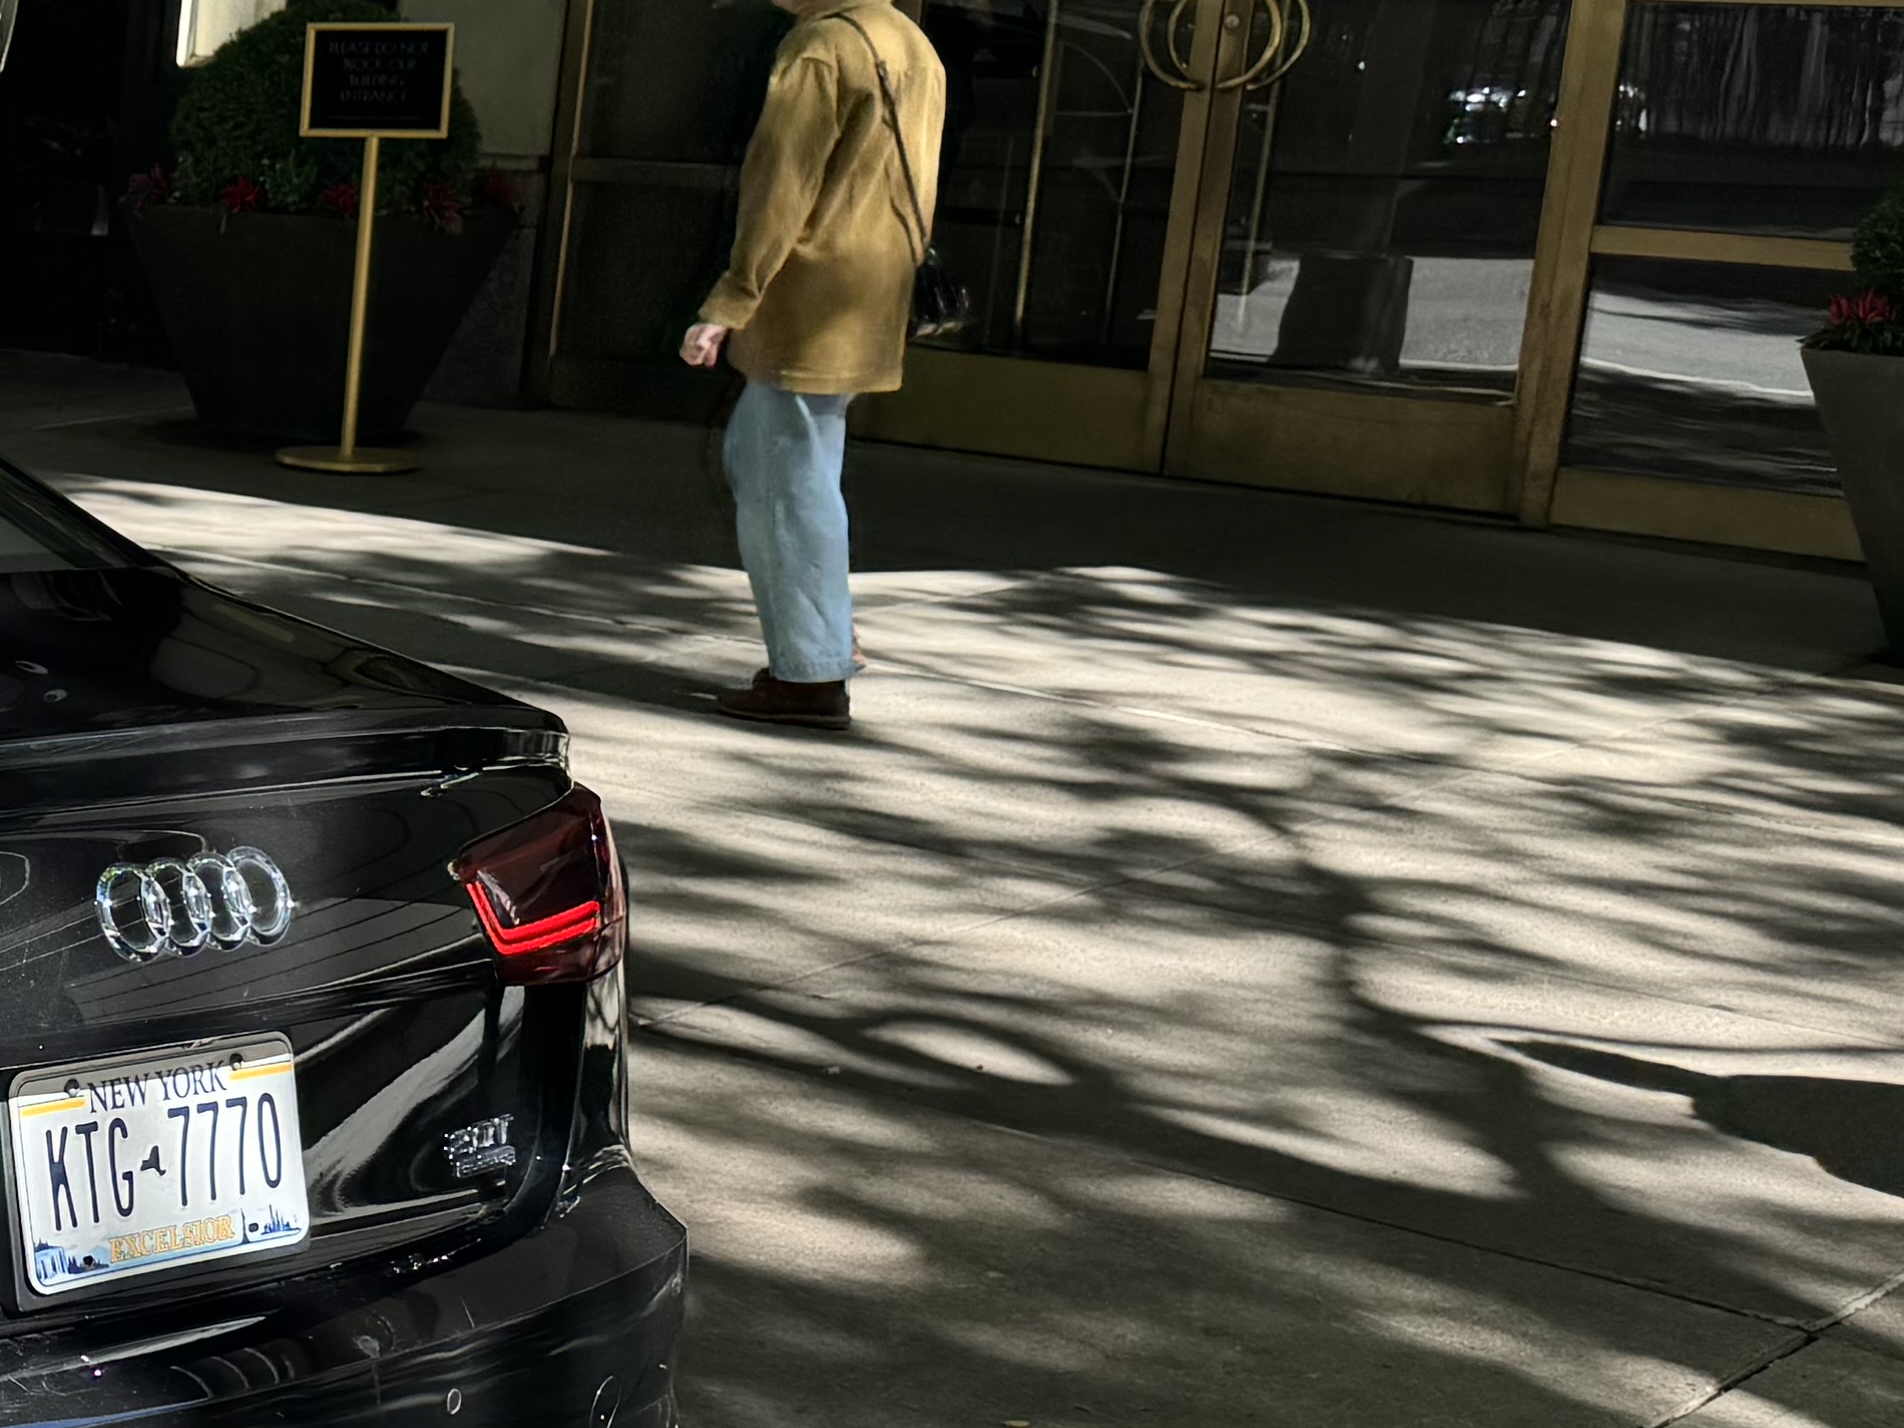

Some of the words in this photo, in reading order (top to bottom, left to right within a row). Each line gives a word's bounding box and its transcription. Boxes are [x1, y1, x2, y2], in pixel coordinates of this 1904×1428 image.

[329, 41, 370, 55] PLEASE
[375, 41, 397, 55] DO
[400, 41, 429, 55] NOT
[87, 1073, 149, 1114] NEW
[154, 1059, 228, 1102] YORK
[45, 1117, 135, 1232] KTG
[167, 1092, 283, 1207] 7770
[108, 1213, 236, 1264] EXCELSIOR
